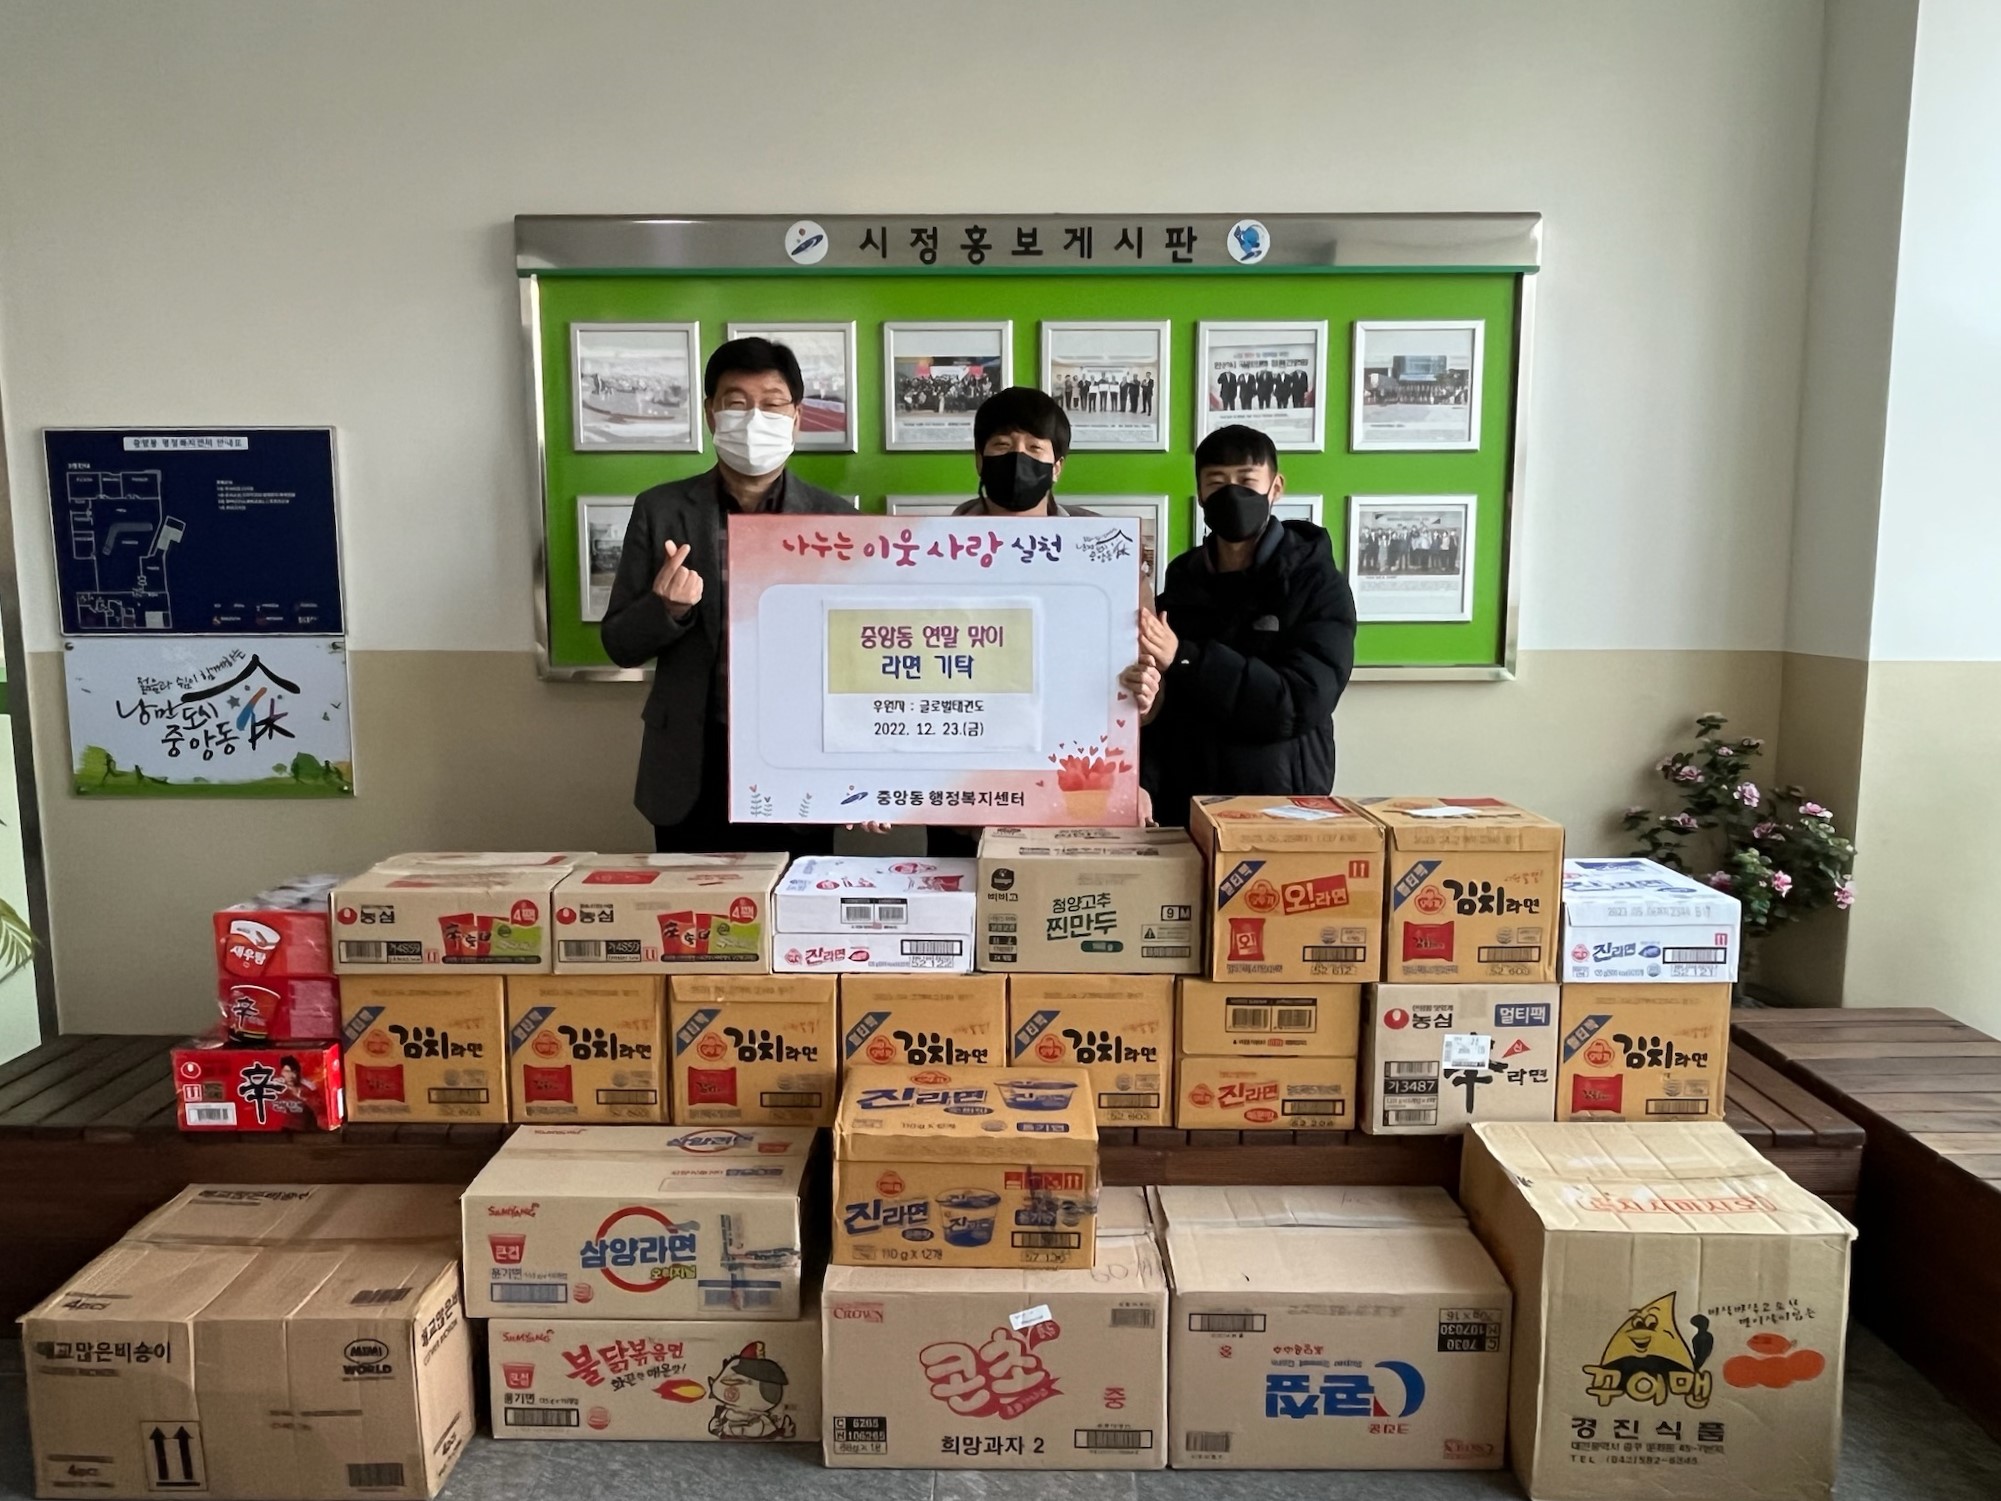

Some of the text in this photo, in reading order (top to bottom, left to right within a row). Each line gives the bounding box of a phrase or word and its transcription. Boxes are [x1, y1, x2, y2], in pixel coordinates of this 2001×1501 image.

[859, 225, 1198, 264] 시정홍보게시판
[782, 531, 854, 561] 나누는
[863, 528, 921, 567] 이웃
[927, 531, 1003, 568] 사랑
[1011, 534, 1062, 563] 실천
[860, 626, 1004, 648] 중앙동 연말 맞이
[881, 655, 974, 679] 라면 기탁
[873, 700, 905, 713] 후원자
[919, 700, 984, 713] 글로벌태권도
[162, 721, 240, 761] 중앙동
[874, 722, 909, 736] 2022.
[943, 722, 984, 737] 23.(금)
[877, 790, 1025, 806] 중앙동 행정복지센터
[1053, 893, 1111, 913] 청양고추
[1443, 879, 1540, 915] 김치라면
[1167, 907, 1174, 919] 9
[1047, 911, 1117, 941] 찐만두
[1412, 1013, 1453, 1029] 농심
[1500, 1006, 1546, 1025] 멀티팩
[1507, 1068, 1548, 1086] 라면
[237, 1061, 287, 1124] 辛
[856, 1087, 988, 1109] 진라면
[1218, 1081, 1279, 1109] 진라면
[844, 1199, 928, 1236] 진라면
[580, 1234, 696, 1268] 삼양라면
[343, 1364, 392, 1375] WORLD
[562, 1339, 684, 1387] 불닭볶음면
[1571, 1417, 1725, 1442] 경진식품
[941, 1436, 1045, 1456] 희망과자 2
